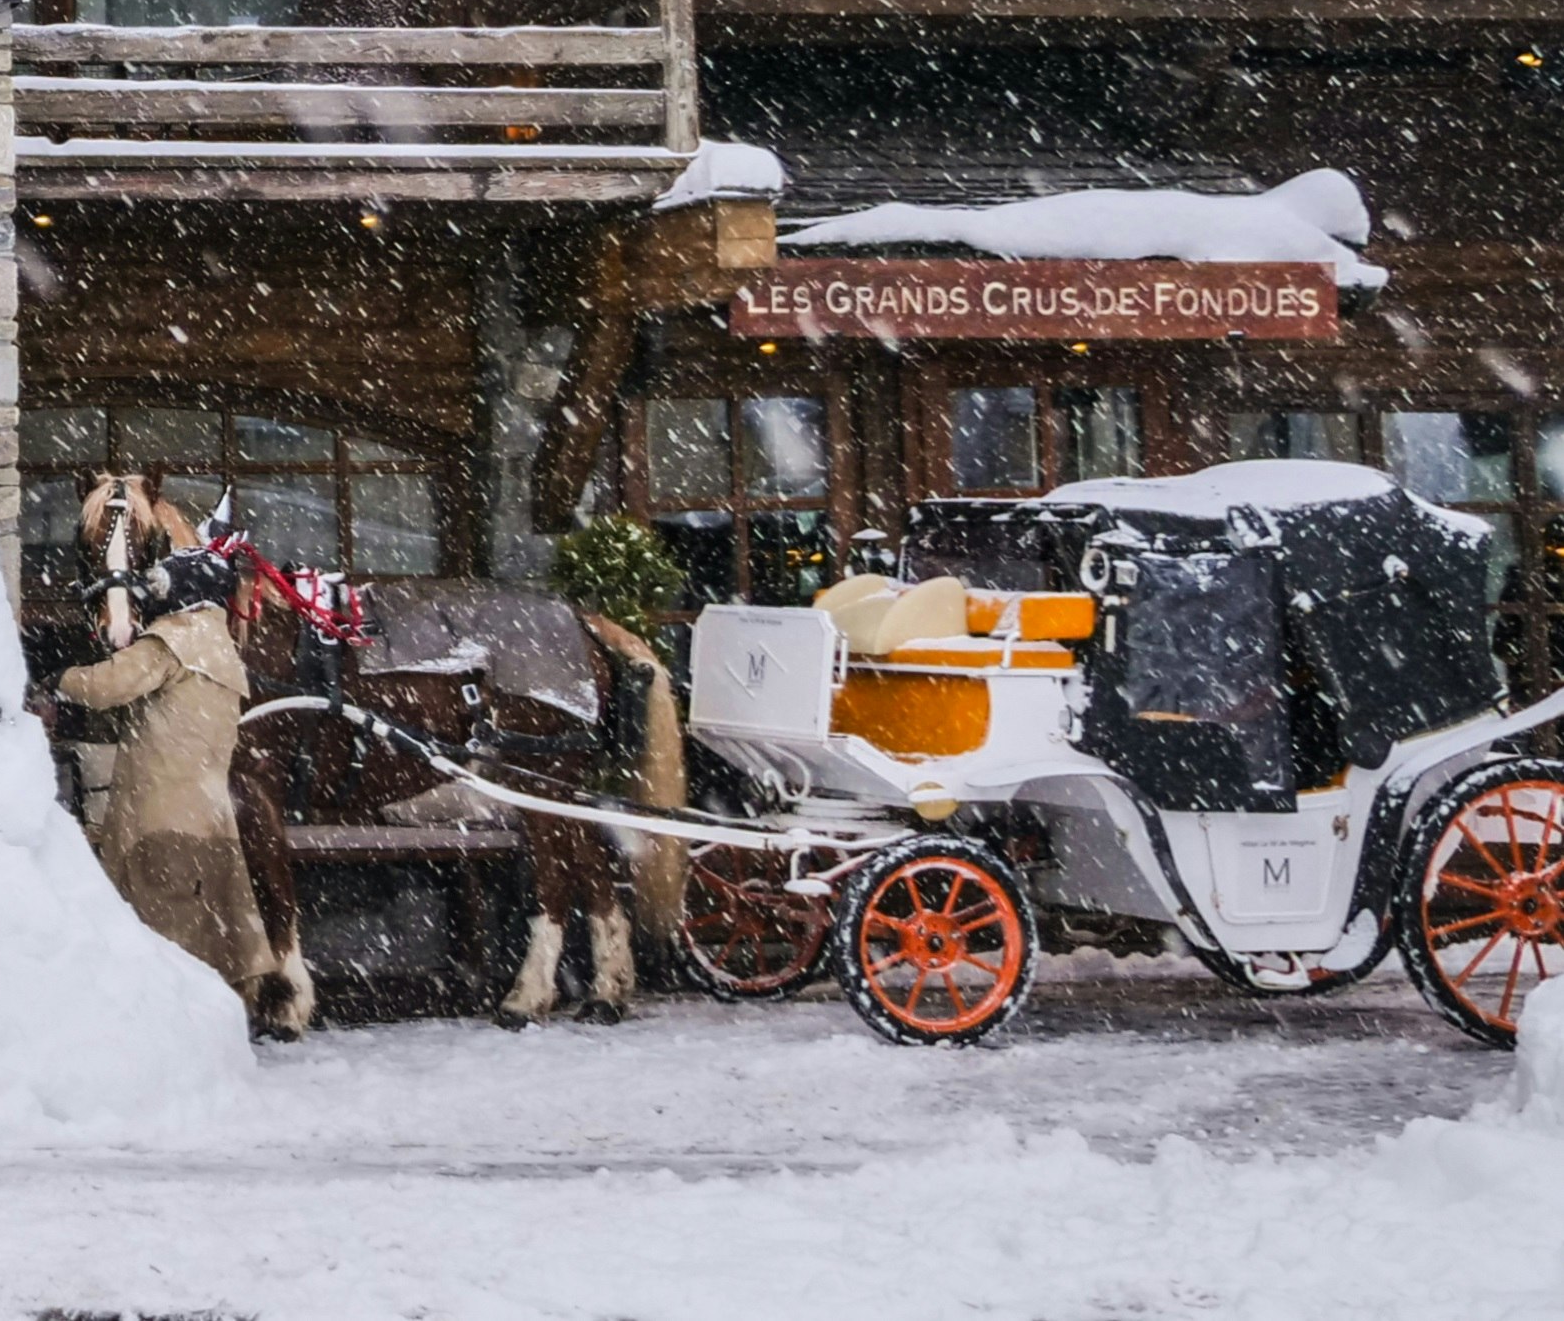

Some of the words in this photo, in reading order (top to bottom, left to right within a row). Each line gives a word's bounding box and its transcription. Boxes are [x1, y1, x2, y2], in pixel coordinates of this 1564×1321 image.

[825, 281, 971, 315] GRANDS
[982, 281, 1079, 316] CRUS
[1095, 287, 1140, 316] DE
[1154, 282, 1320, 317] FONDUES
[1264, 858, 1290, 885] M
